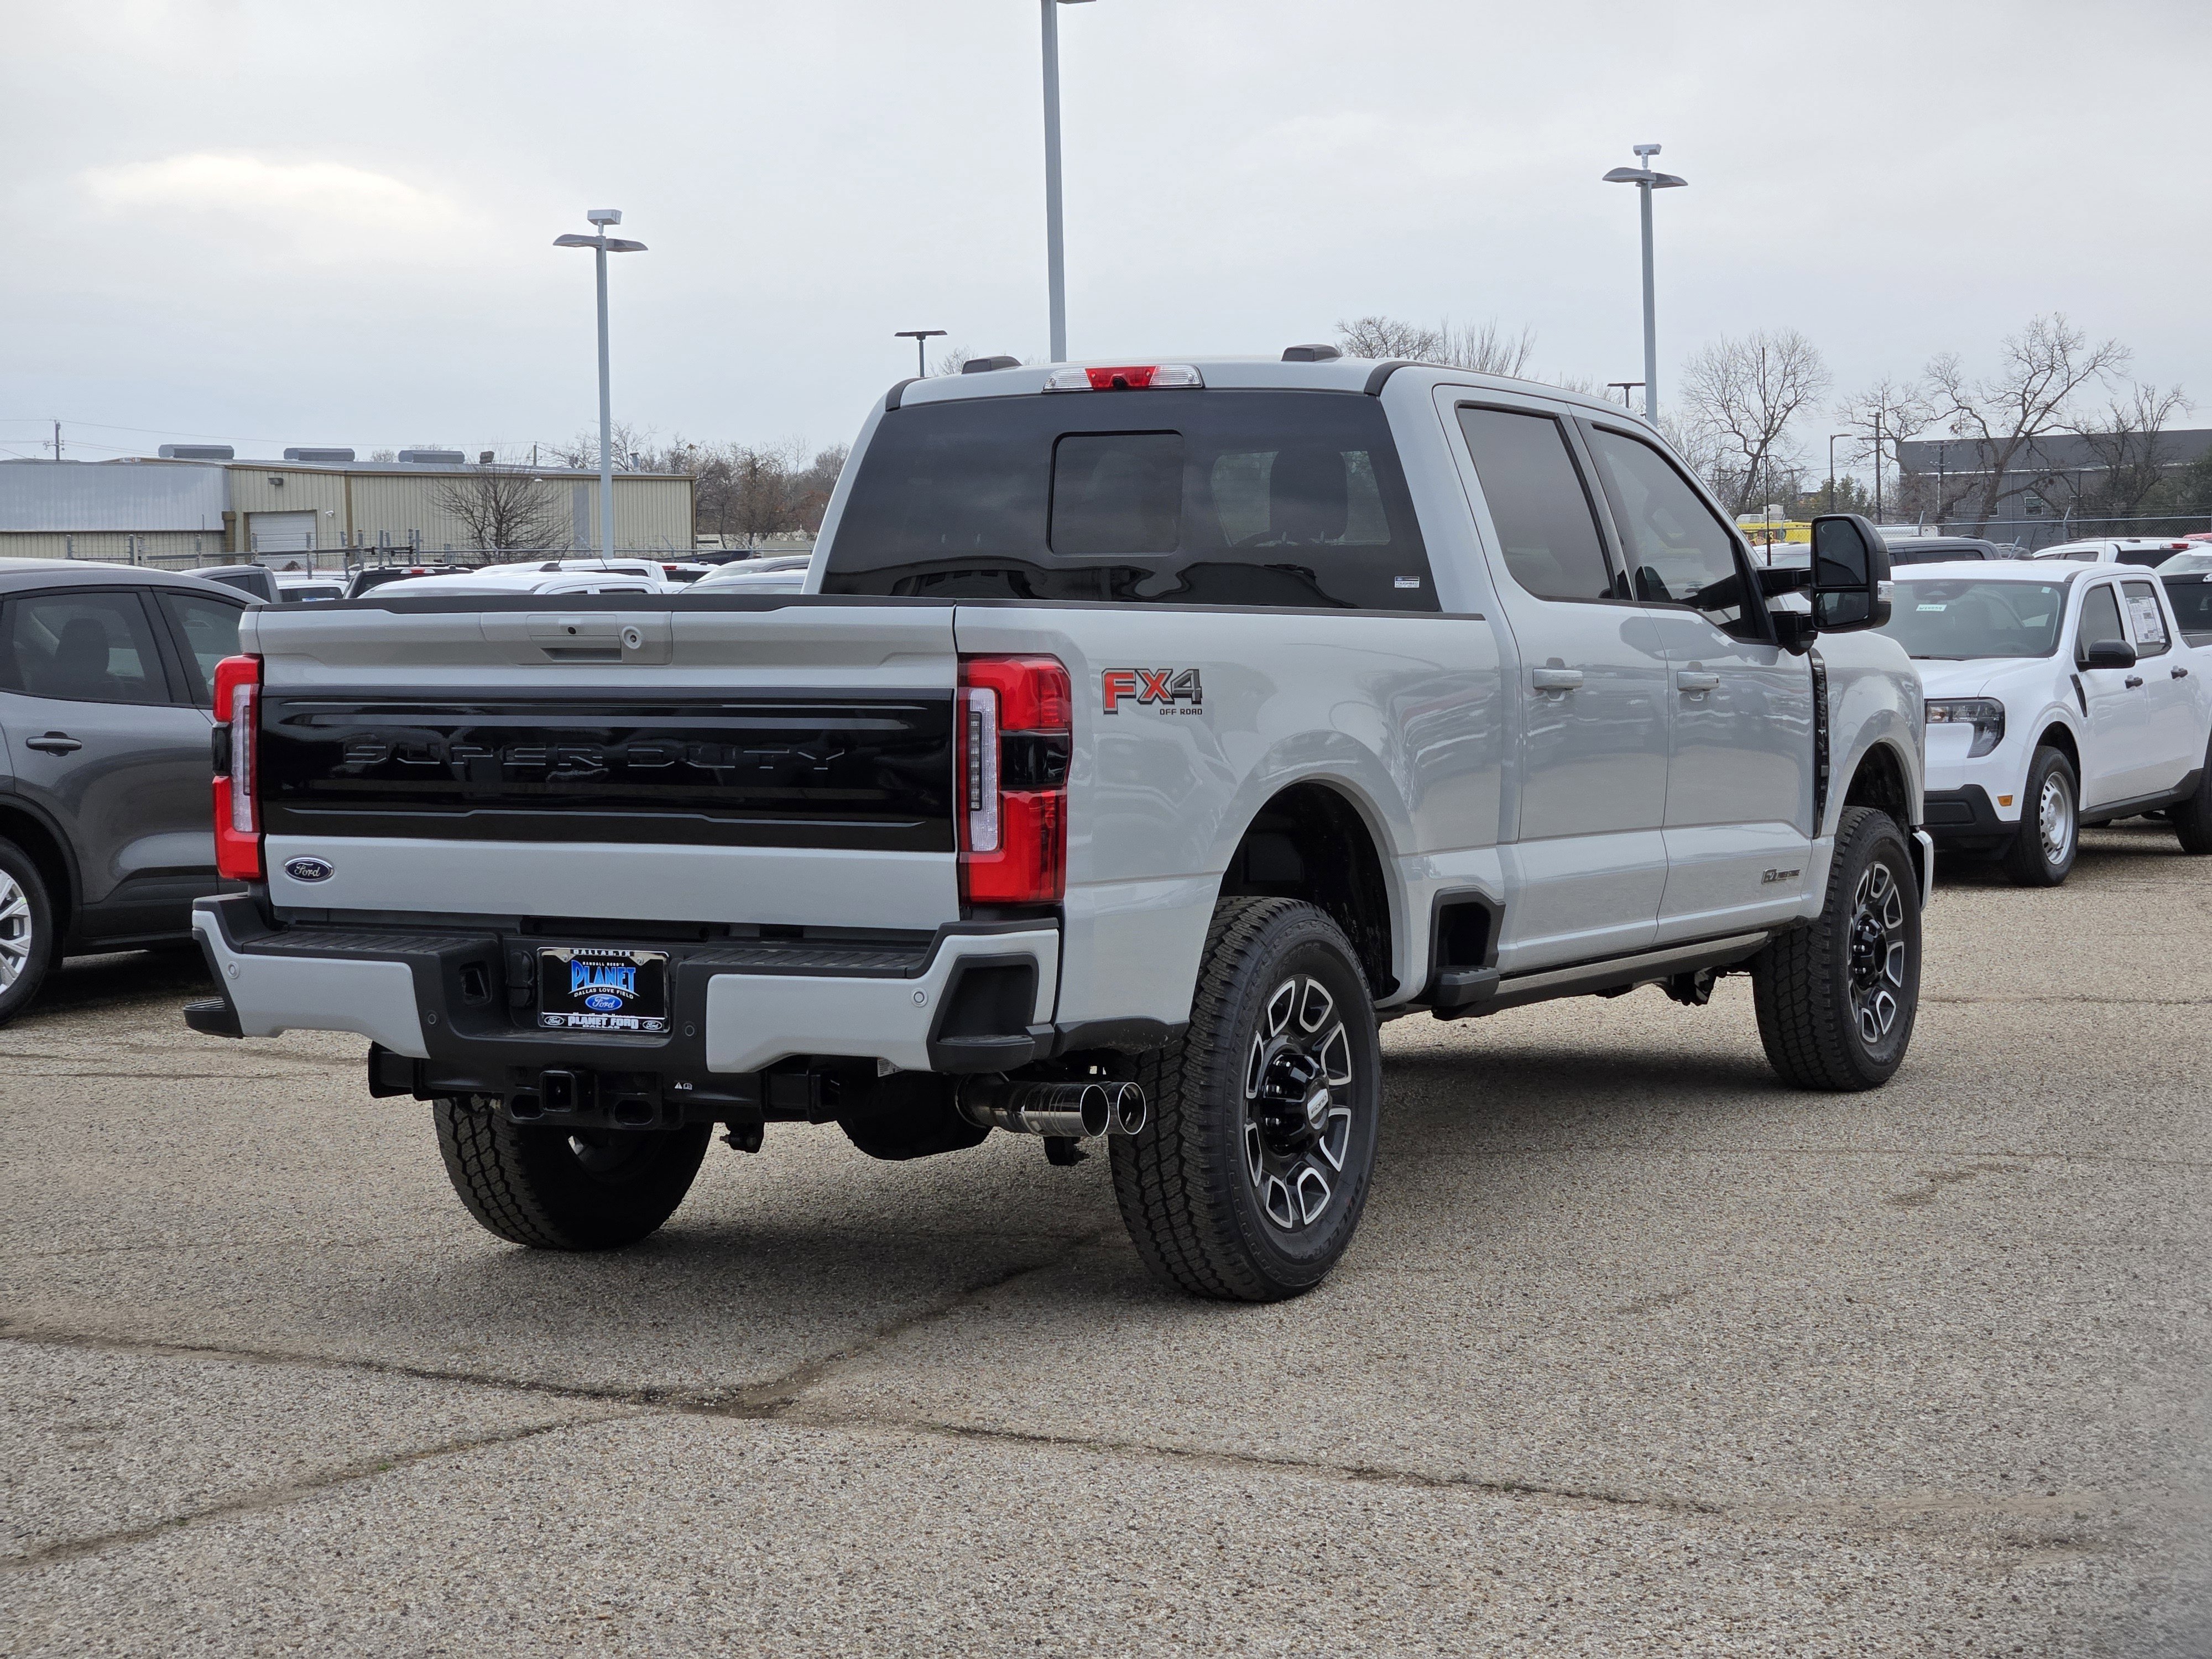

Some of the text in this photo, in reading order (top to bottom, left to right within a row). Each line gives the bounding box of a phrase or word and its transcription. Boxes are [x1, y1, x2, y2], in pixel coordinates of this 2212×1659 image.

[1102, 668, 1202, 715] FX4
[343, 742, 845, 770] SUPER DUTY
[294, 862, 321, 877] Ford
[571, 959, 636, 993] PLANET
[574, 988, 597, 998] DALLAS
[616, 989, 634, 999] FIELD
[592, 997, 615, 1009] Ford
[567, 1016, 639, 1030] PLANET FORD
[1311, 1095, 1327, 1115] FORD
